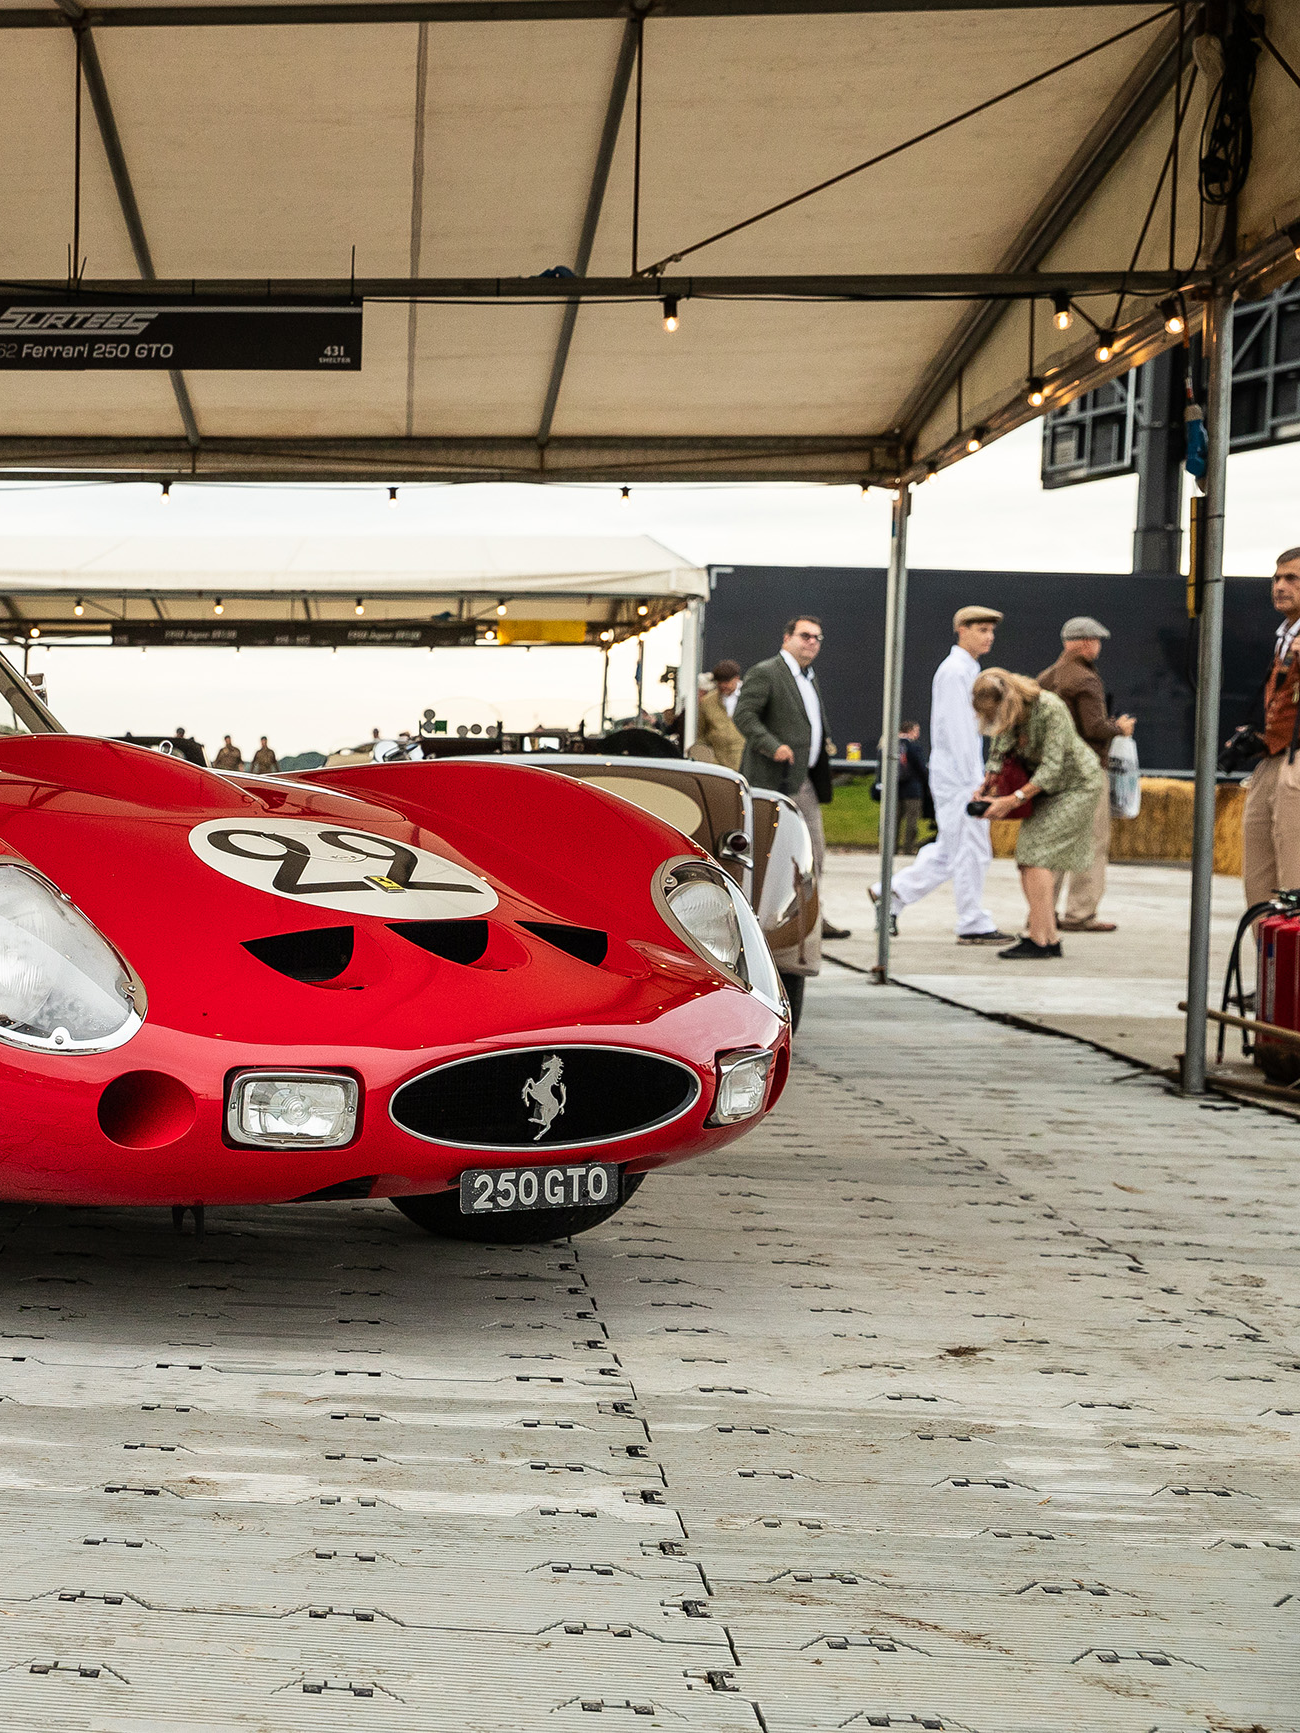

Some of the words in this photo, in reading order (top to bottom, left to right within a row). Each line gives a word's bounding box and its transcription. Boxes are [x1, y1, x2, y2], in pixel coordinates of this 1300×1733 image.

[21, 343, 89, 359] Ferrari
[92, 343, 130, 359] 250
[134, 343, 175, 359] GTO
[323, 345, 345, 356] 431
[206, 829, 485, 895] 22
[473, 1171, 539, 1210] 250
[544, 1166, 609, 1204] GTO
